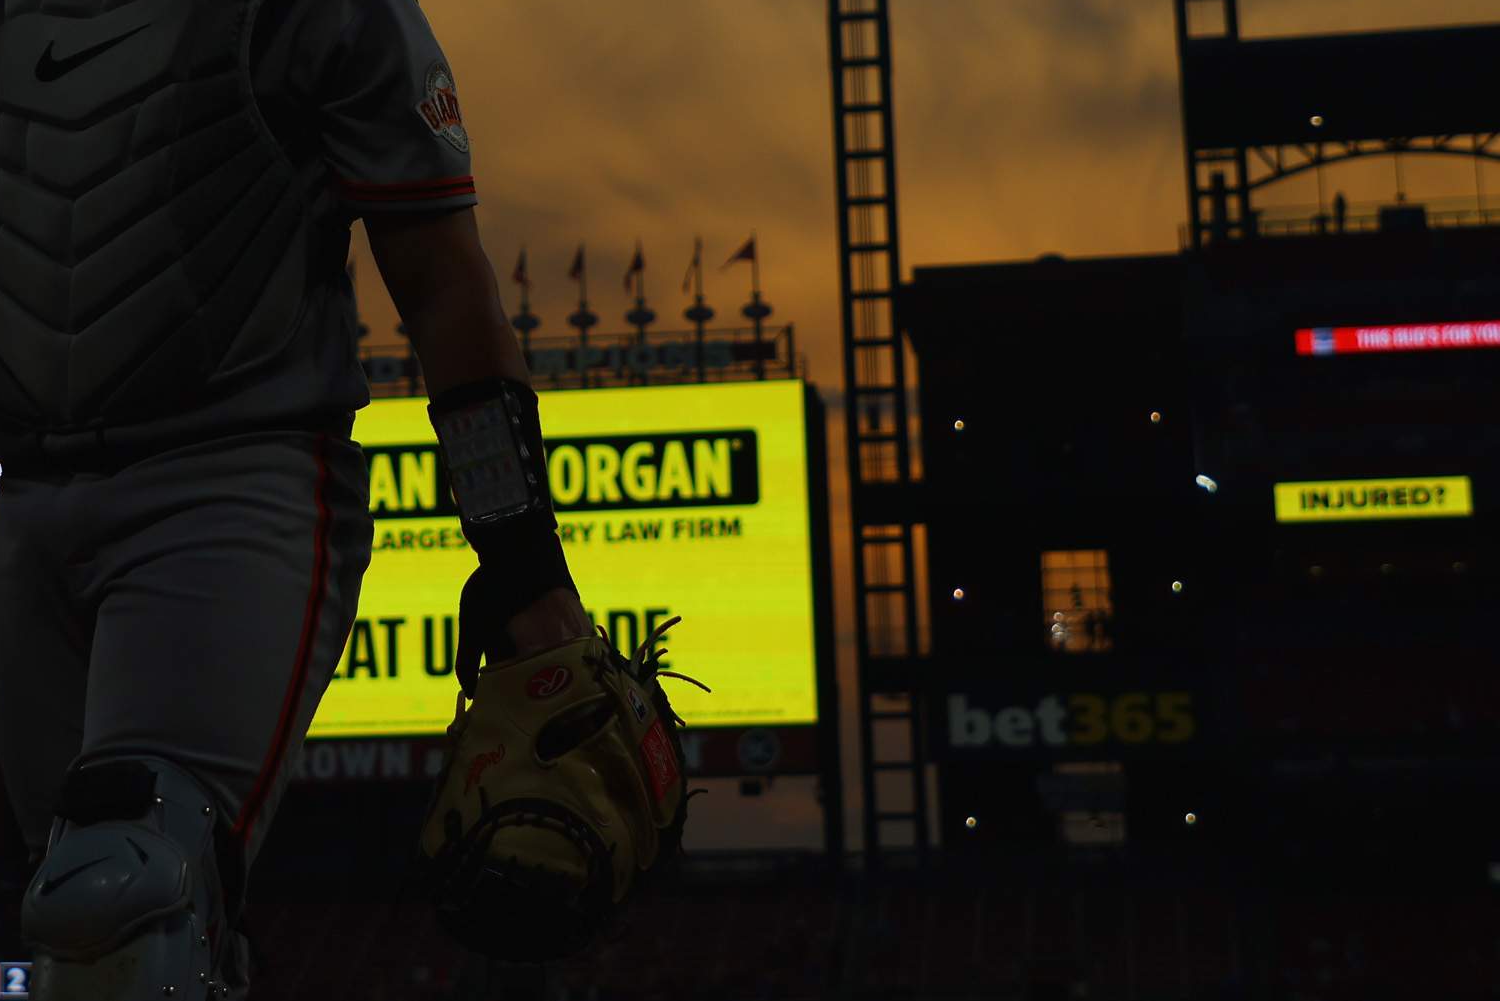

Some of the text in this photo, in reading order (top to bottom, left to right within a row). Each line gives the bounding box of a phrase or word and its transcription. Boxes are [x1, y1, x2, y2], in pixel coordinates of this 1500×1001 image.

[369, 452, 437, 511] AN
[549, 439, 732, 505] ORGAN
[1301, 486, 1445, 510] INJURED?
[372, 517, 741, 552] ARGES RY LAW FIRM
[333, 619, 405, 679] AT
[948, 691, 1197, 746] bet365
